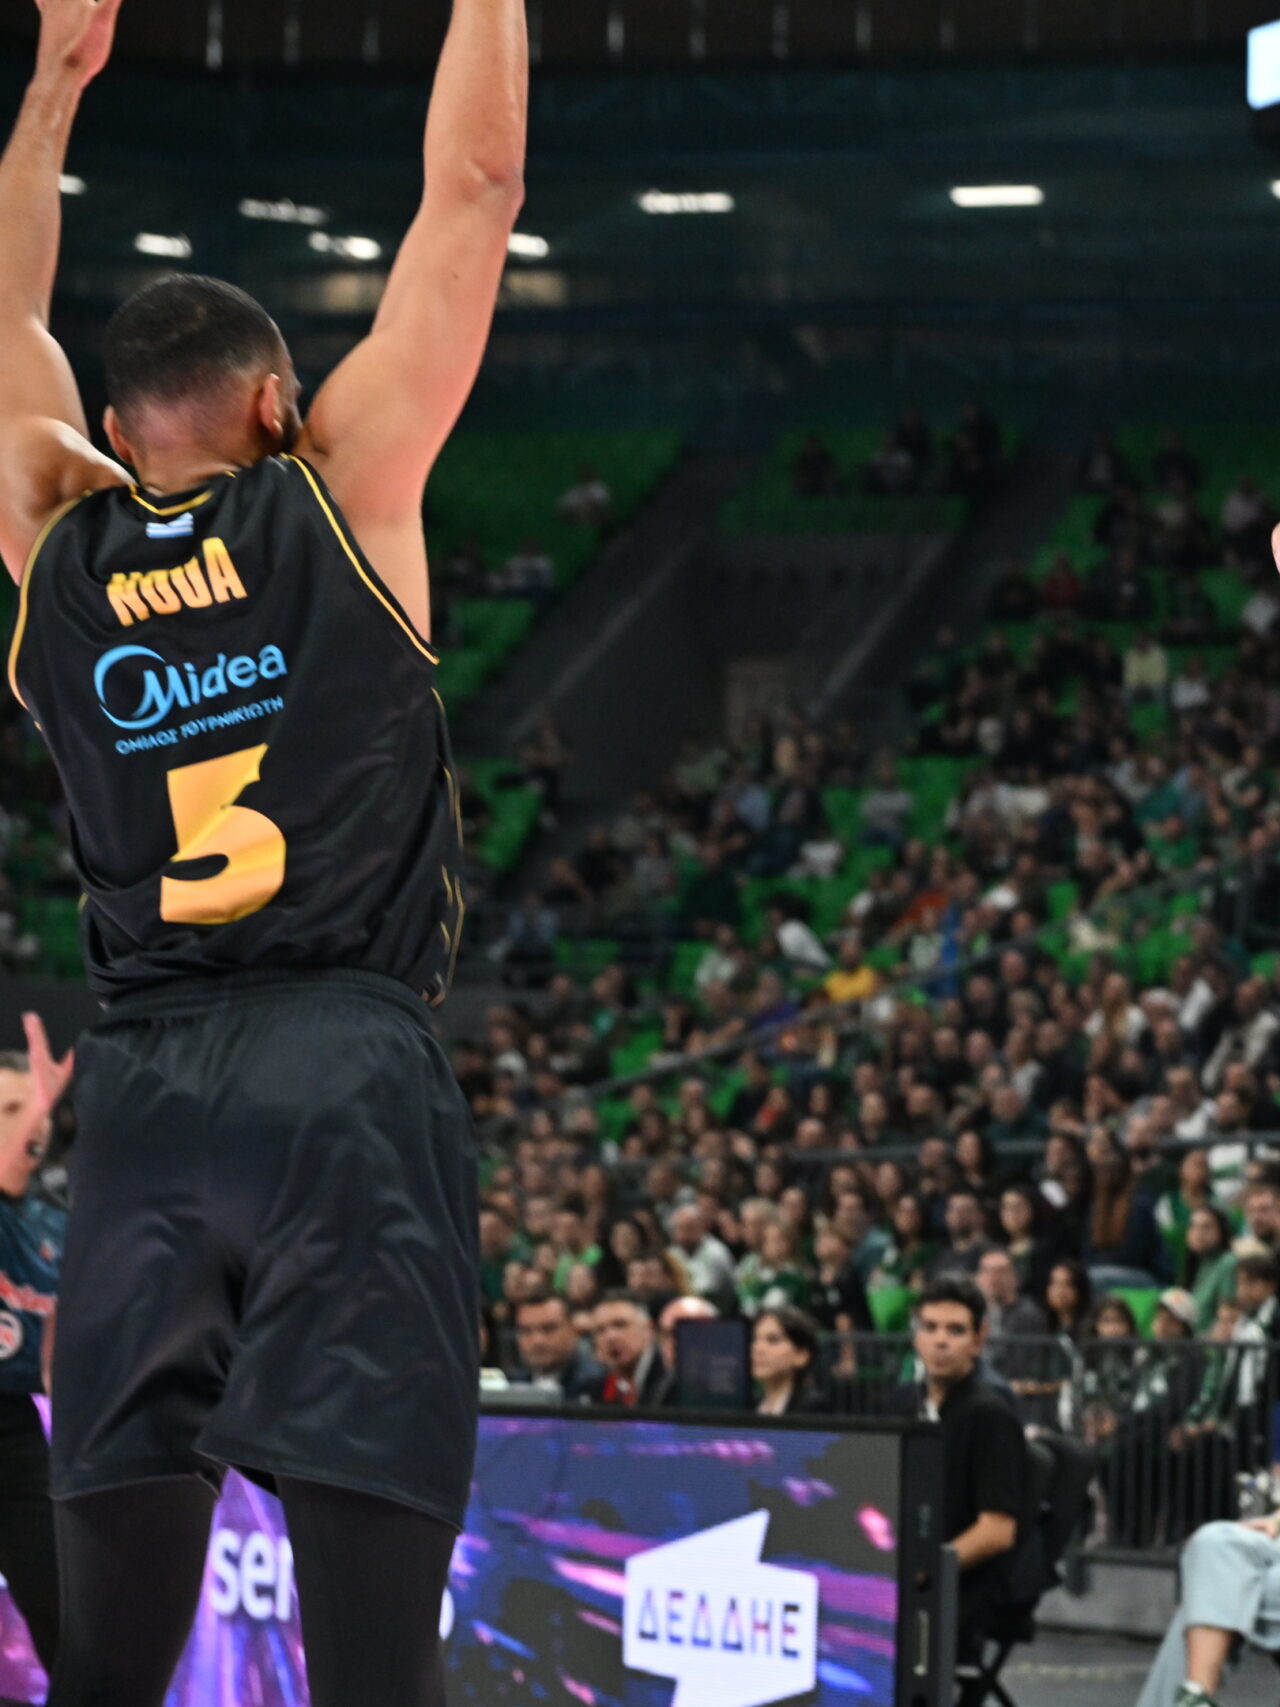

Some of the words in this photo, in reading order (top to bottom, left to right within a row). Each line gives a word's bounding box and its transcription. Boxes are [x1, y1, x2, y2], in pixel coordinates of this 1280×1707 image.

[131, 644, 288, 722] Midea
[160, 742, 287, 925] 5
[638, 1587, 800, 1659] ΔΕΔΔΗΕ
